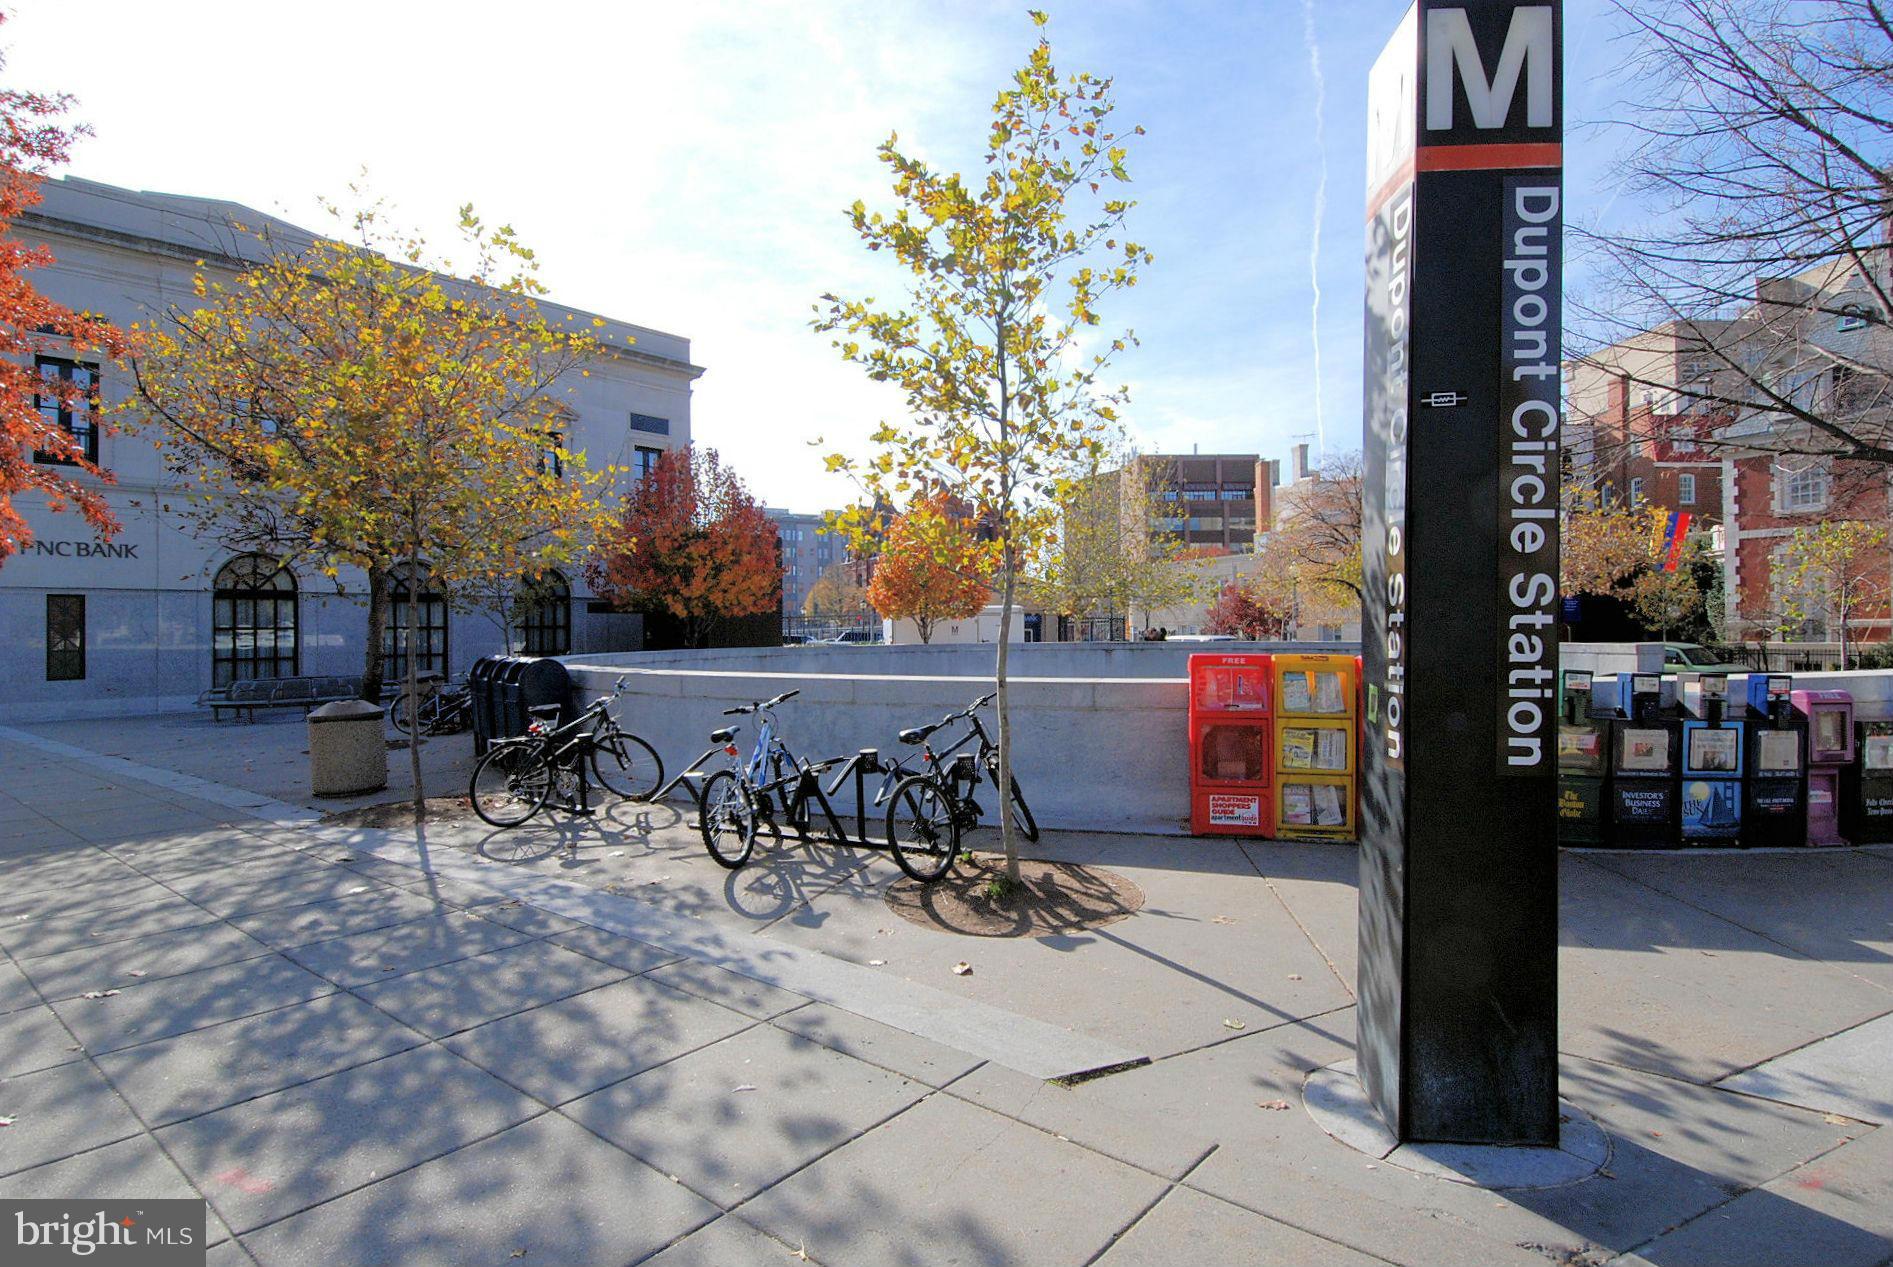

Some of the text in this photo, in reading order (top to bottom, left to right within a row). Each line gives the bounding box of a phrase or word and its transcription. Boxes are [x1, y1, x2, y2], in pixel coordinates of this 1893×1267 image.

[1427, 6, 1553, 131] M
[1388, 196, 1411, 393] Dupont
[1503, 186, 1560, 766] Dupont Circle Station
[75, 541, 139, 559] BANK
[1387, 572, 1405, 759] Station
[1622, 791, 1664, 800] INVESTOR'S
[1625, 800, 1661, 809] BUSINESS
